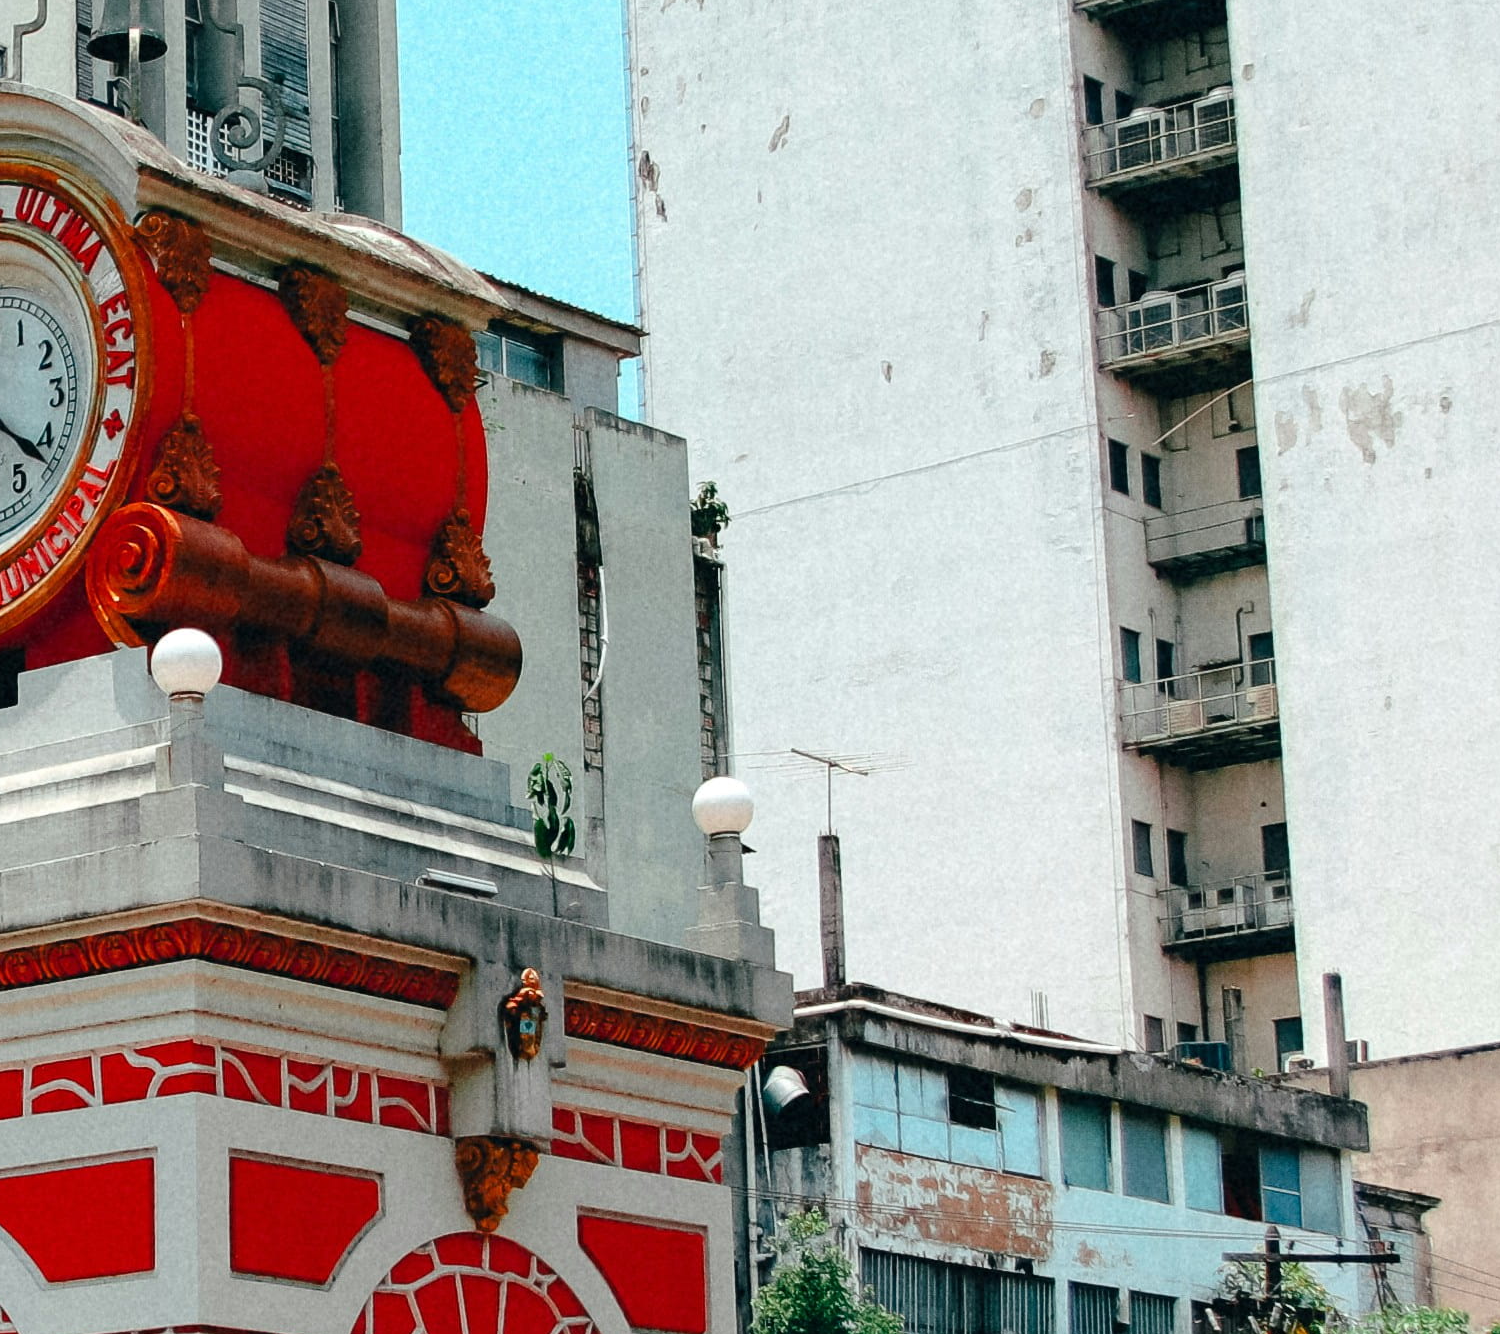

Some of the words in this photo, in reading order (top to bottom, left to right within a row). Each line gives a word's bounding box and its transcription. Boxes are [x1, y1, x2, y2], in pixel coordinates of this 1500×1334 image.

[15, 185, 105, 276] ULTIMA
[16, 319, 25, 347] 1
[37, 339, 53, 371] 2
[49, 376, 65, 408] 3
[36, 421, 55, 449] 4
[12, 463, 27, 493] 5
